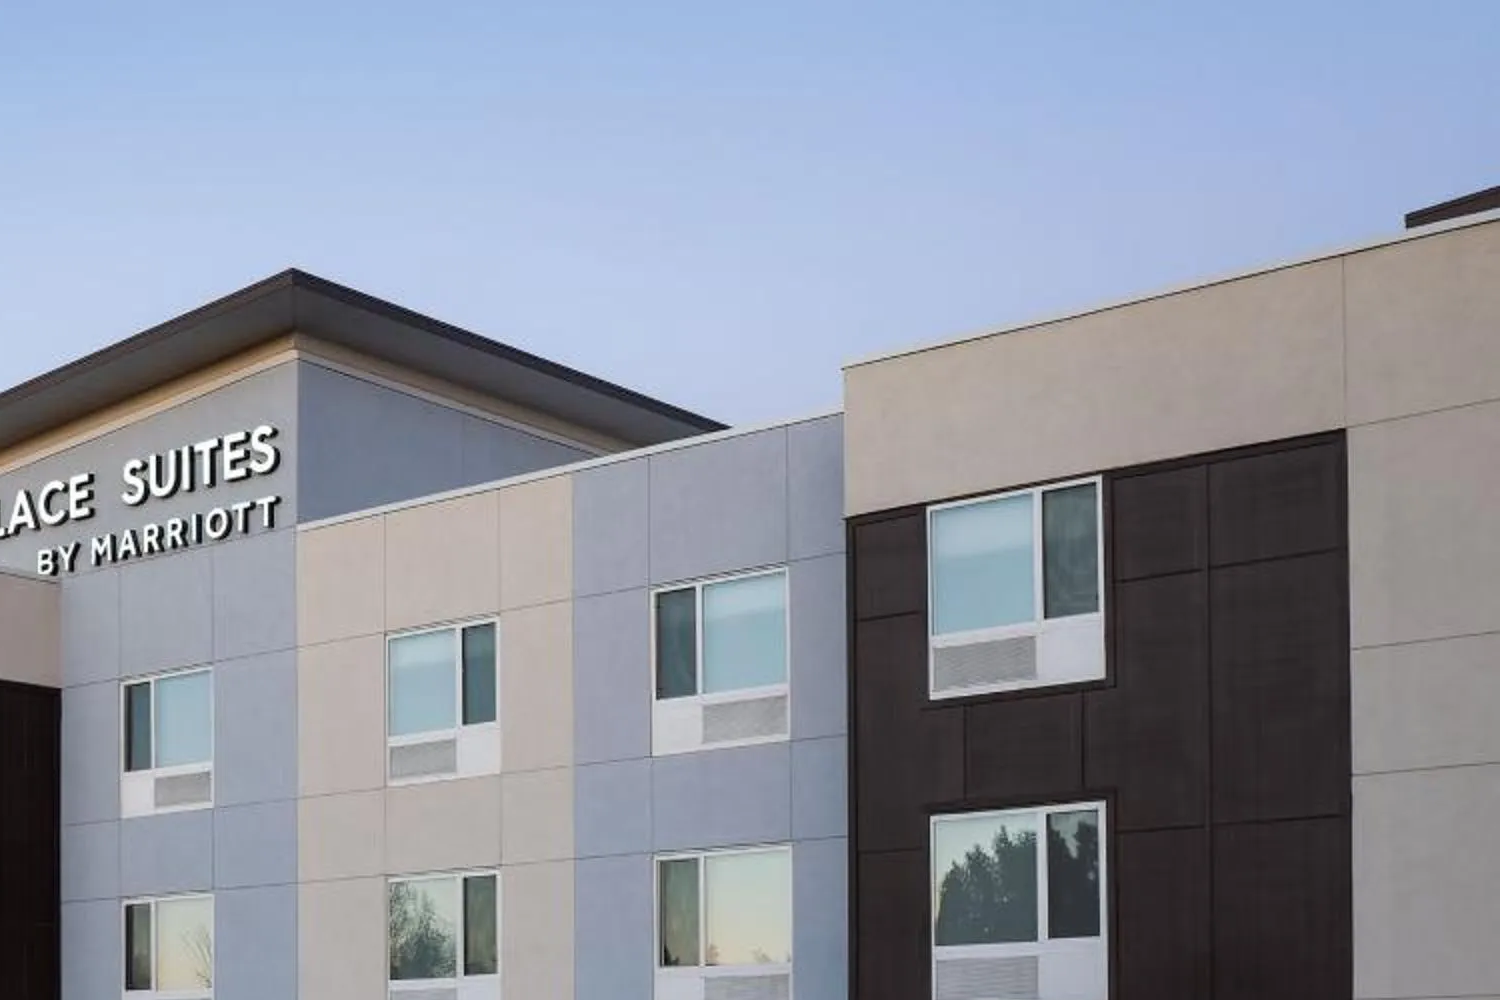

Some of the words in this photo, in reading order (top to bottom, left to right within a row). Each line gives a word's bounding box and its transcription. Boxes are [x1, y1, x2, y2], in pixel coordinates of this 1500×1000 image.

[121, 424, 279, 506] SUITES
[36, 541, 79, 576] BY
[90, 495, 280, 566] MARRIOTT
